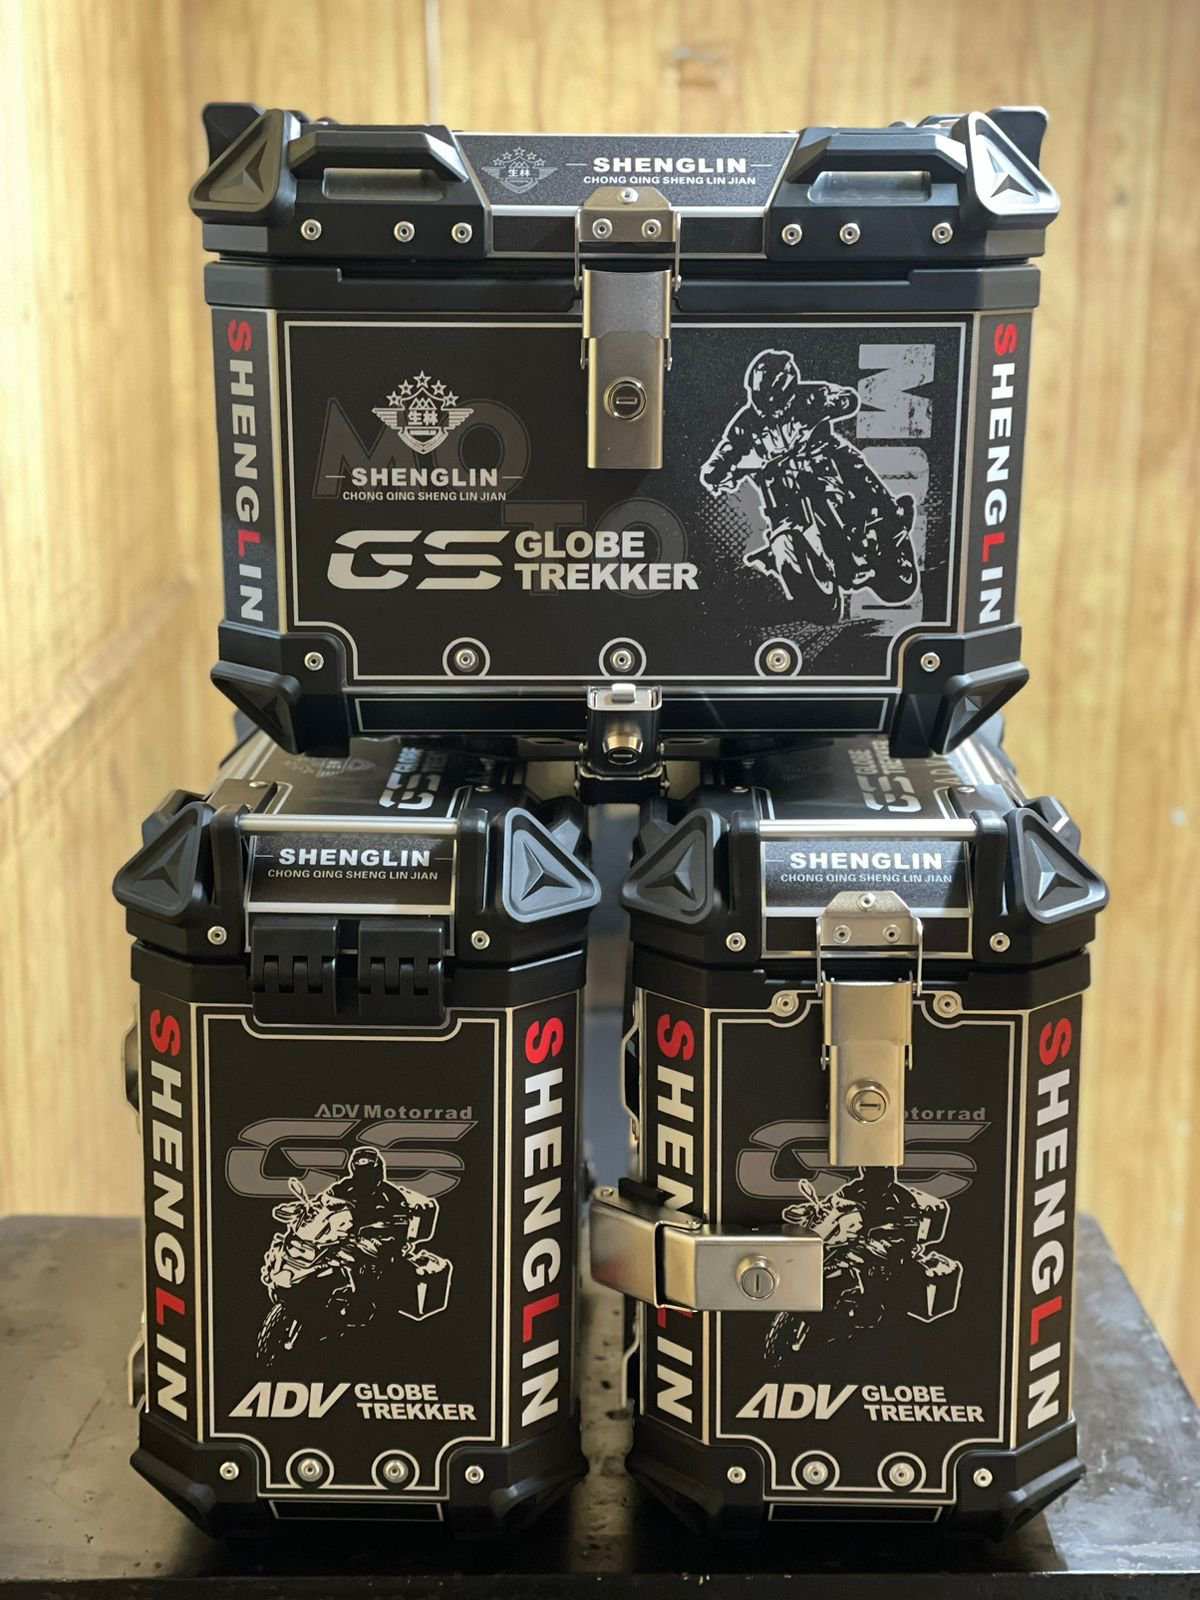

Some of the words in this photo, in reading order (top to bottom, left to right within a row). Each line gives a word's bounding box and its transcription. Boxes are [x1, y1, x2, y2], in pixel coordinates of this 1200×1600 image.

[593, 157, 747, 174] SHENGLIN
[583, 176, 627, 185] CHONG
[629, 176, 660, 185] QING
[662, 176, 704, 185] SHENG
[706, 176, 726, 185] LIN
[727, 176, 756, 185] JIAN
[227, 319, 264, 622] SHENGLIN
[351, 467, 498, 486] SHENGLIN
[979, 323, 1017, 624] SHENGLIN
[343, 491, 384, 501] CHONG
[386, 491, 416, 501] QING
[417, 491, 457, 501] SHENG
[459, 491, 478, 501] LIN
[479, 491, 507, 501] JIAN
[327, 530, 510, 590] GS
[514, 530, 645, 558] GLOBE
[514, 563, 699, 590] TREKKER
[279, 848, 431, 867] SHENGLIN
[790, 852, 943, 870] SHENGLIN
[267, 868, 310, 878] CHONG
[313, 870, 343, 879] QING
[345, 870, 386, 879] SHENG
[389, 871, 408, 879] LIN
[410, 871, 438, 881] JIAN
[780, 873, 823, 883] CHONG
[826, 873, 857, 883] QING
[859, 873, 900, 883] SHENG
[902, 873, 922, 883] LIN
[924, 873, 952, 883] JIAN
[314, 1104, 360, 1118] ADV
[364, 1104, 473, 1120] Motorrad
[225, 1118, 479, 1198] GS
[150, 1008, 187, 1421] SHENGLIN
[522, 1016, 564, 1427] SHENGLIN
[1028, 1017, 1072, 1430] SHENGLIN
[228, 1382, 351, 1419] ADV
[354, 1383, 439, 1401] GLOBE
[735, 1383, 859, 1420] ADV
[861, 1385, 947, 1402] GLOBE
[356, 1402, 477, 1421] TREKKER
[864, 1404, 985, 1422] TREKKER
